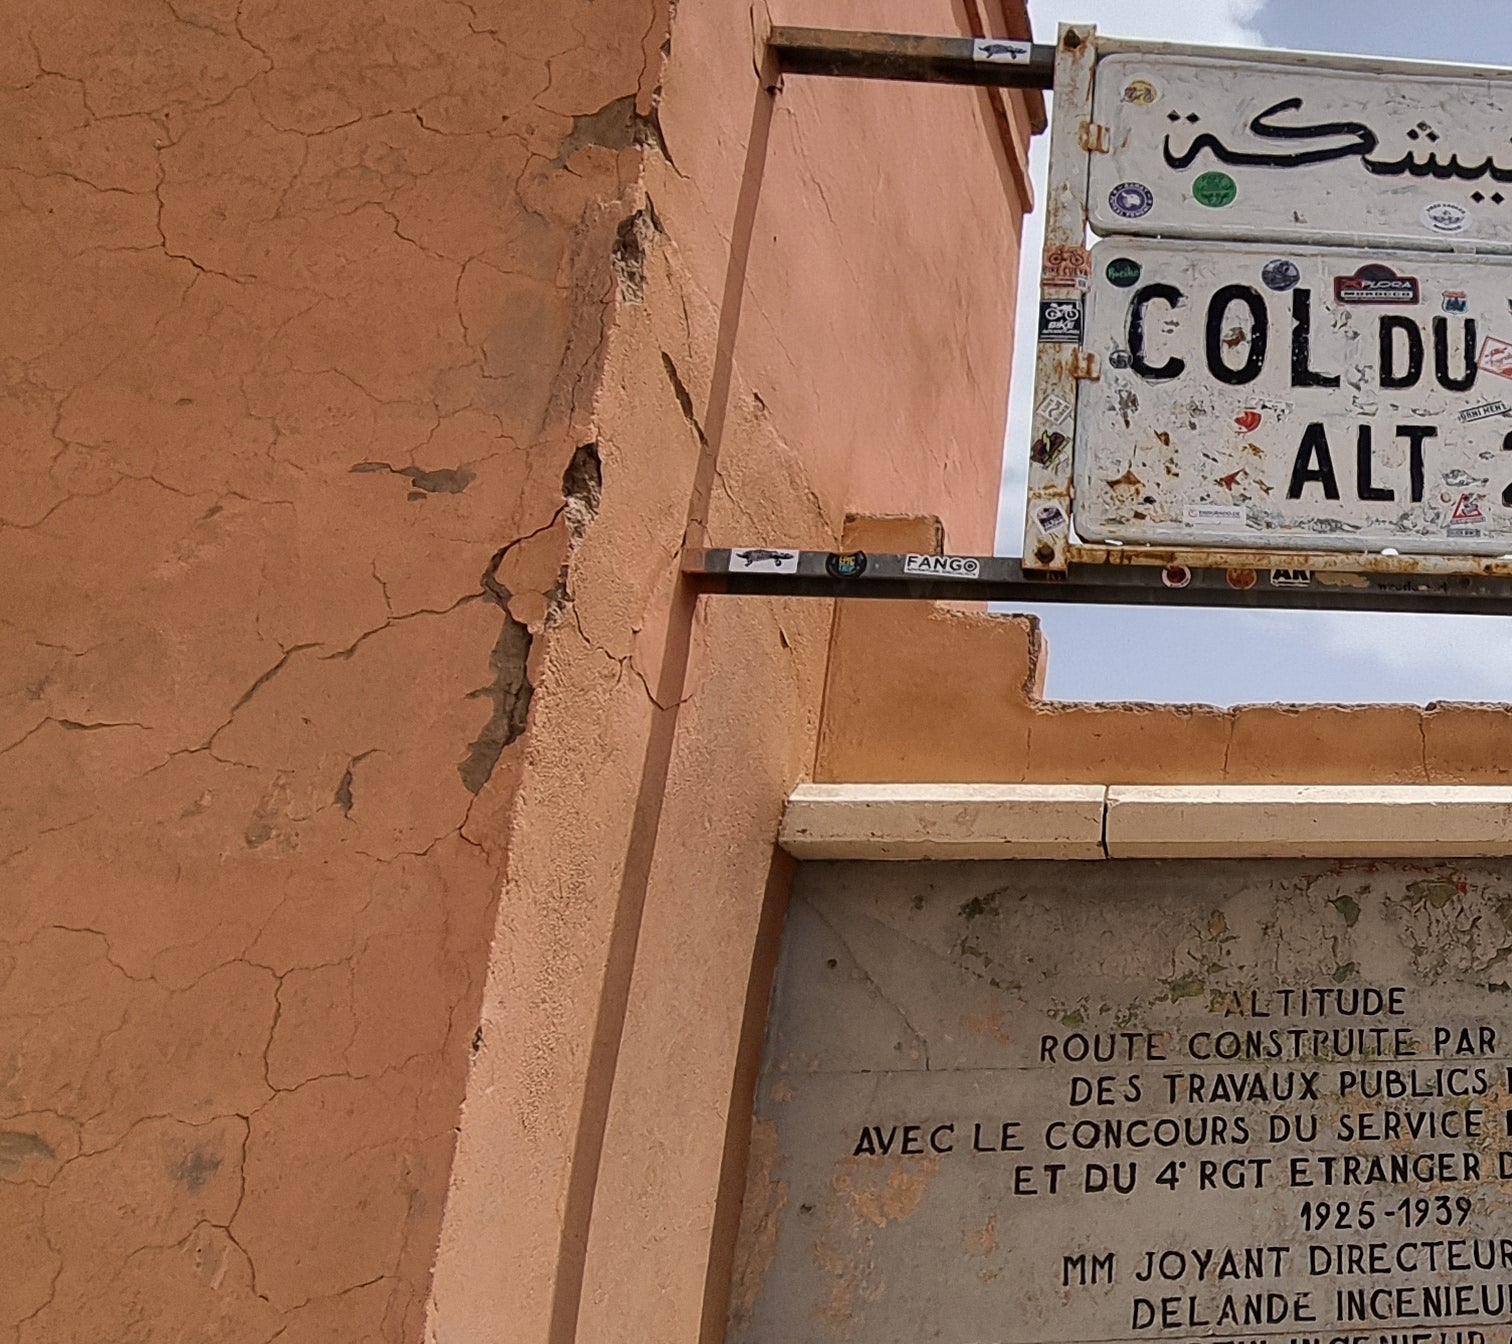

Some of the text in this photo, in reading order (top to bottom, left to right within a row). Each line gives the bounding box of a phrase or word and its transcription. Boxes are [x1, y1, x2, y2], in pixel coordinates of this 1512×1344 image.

[1127, 284, 1341, 388] COL
[1379, 314, 1478, 392] DU
[1286, 422, 1438, 503] ALT
[1041, 1032, 1166, 1063] ROUTE
[1189, 1028, 1416, 1059] CONSTRUITE
[1435, 1026, 1495, 1056] PAR
[1070, 1075, 1141, 1106] DES
[1163, 1072, 1319, 1104] TRAVAUX
[1340, 1069, 1487, 1098] PUBLICS
[853, 1123, 954, 1156] AVEC
[974, 1122, 1024, 1152] LE
[1046, 1116, 1249, 1150] CONCOURS
[1269, 1114, 1317, 1143] DU
[1338, 1109, 1482, 1142] SERVICE
[1014, 1164, 1065, 1195] ET
[1085, 1162, 1136, 1194] DU
[1200, 1159, 1271, 1190] RGT
[1290, 1153, 1480, 1187] ETRANGER
[1301, 1196, 1472, 1231] 1925-1939
[1063, 1253, 1115, 1286] MM
[1136, 1247, 1290, 1281] JOYANT
[1132, 1293, 1316, 1330] DELANDE
